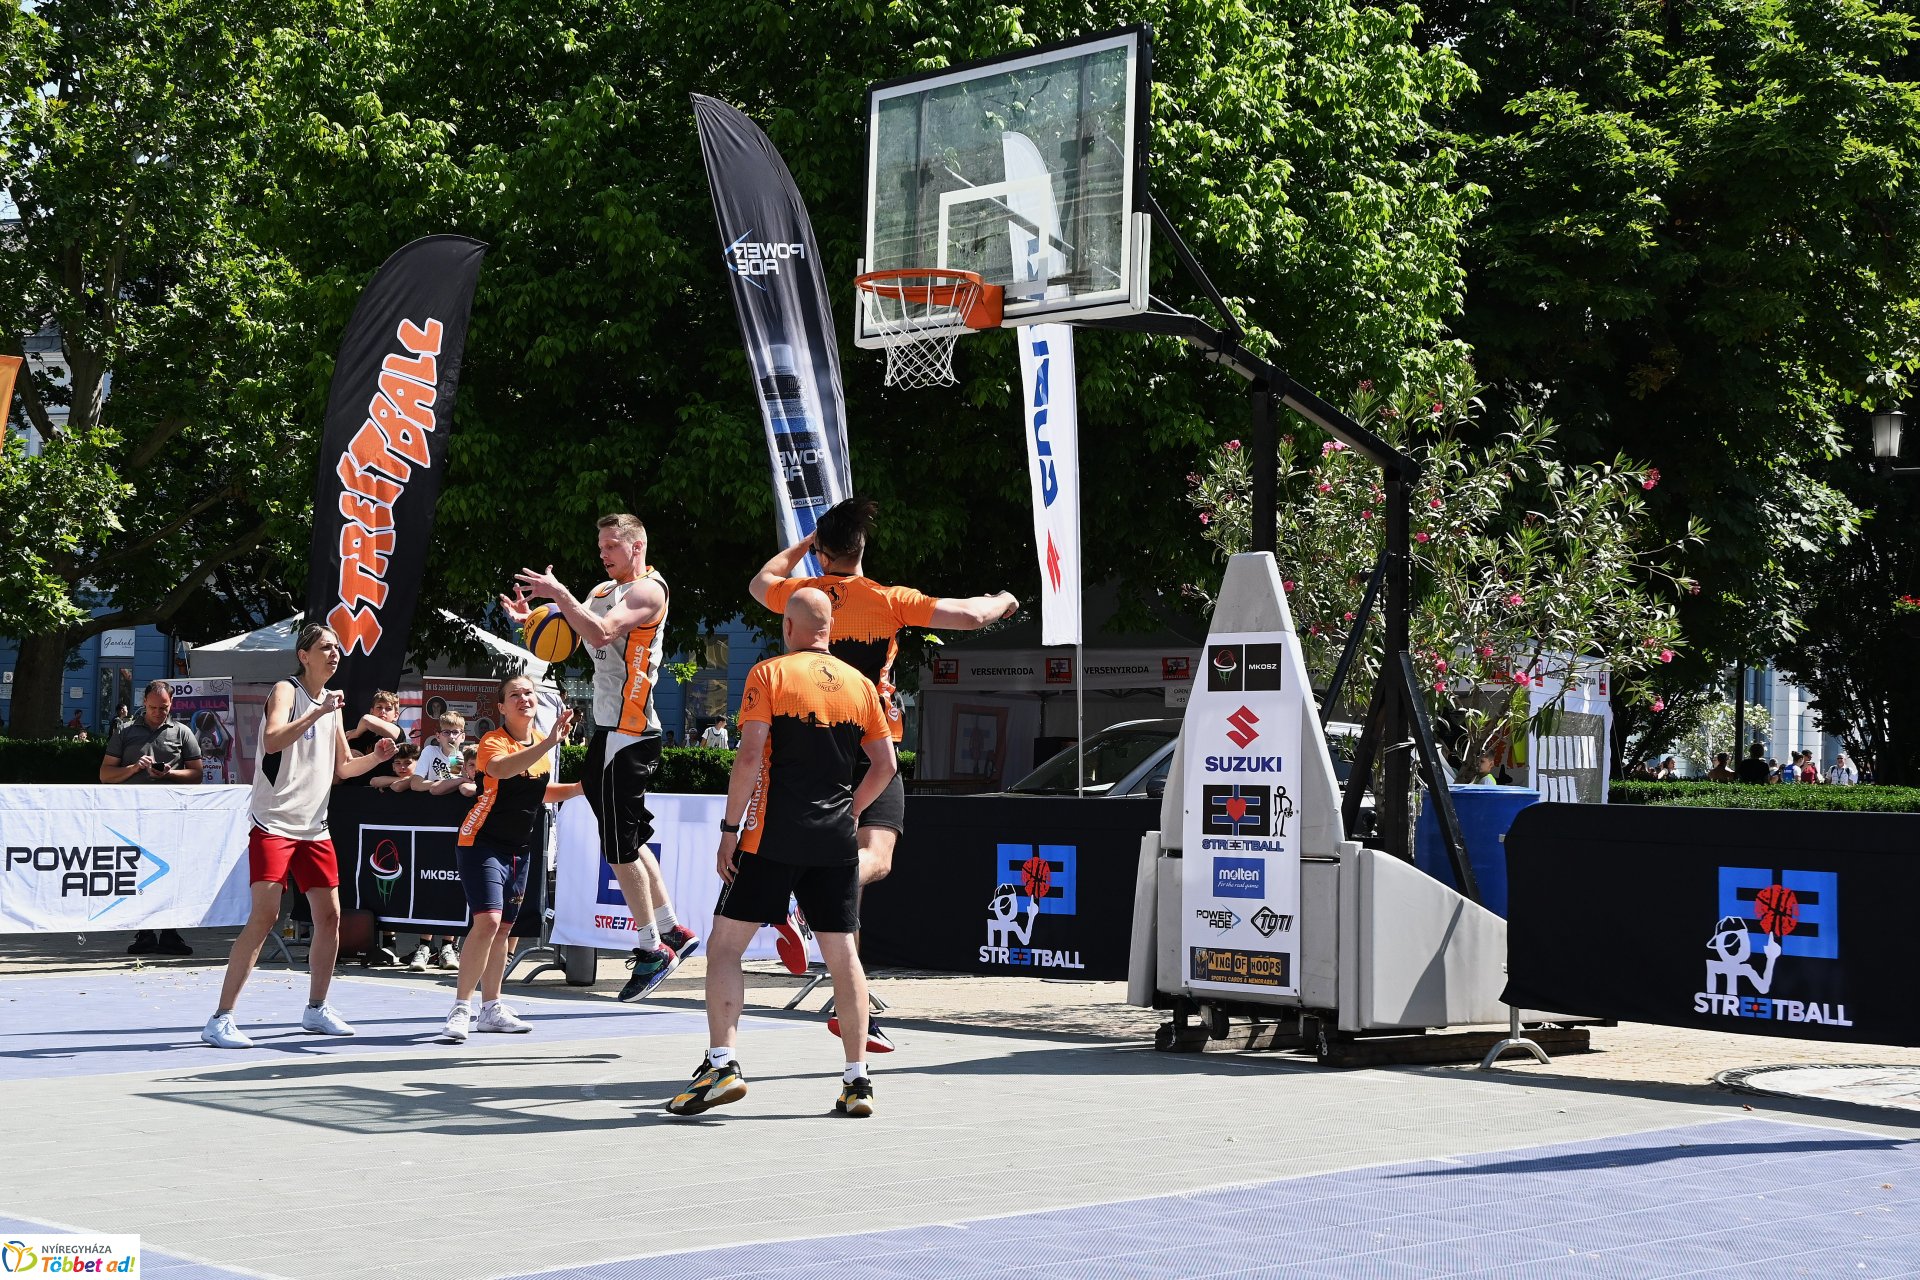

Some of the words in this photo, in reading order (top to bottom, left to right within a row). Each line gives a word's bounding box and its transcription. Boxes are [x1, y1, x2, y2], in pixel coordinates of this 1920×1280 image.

[326, 317, 444, 657] STREETBALL
[971, 667, 1034, 676] VERSENYIRODA
[1084, 666, 1149, 675] VERSENYIRODA
[201, 700, 228, 709] LILLA
[1205, 757, 1281, 772] SUZUKI
[1202, 839, 1284, 852] STREETBALL
[5, 846, 141, 871] POWER
[1219, 868, 1260, 881] molten
[61, 871, 137, 897] ADE
[1196, 910, 1232, 920] POWER
[1260, 913, 1294, 932] TOTI
[1209, 919, 1232, 929] ADE
[979, 946, 1085, 969] STREETBALL
[1209, 951, 1231, 969] KING
[1234, 957, 1247, 970] OF
[1251, 960, 1281, 973] HOOPS
[1693, 991, 1853, 1027] STREETBALL
